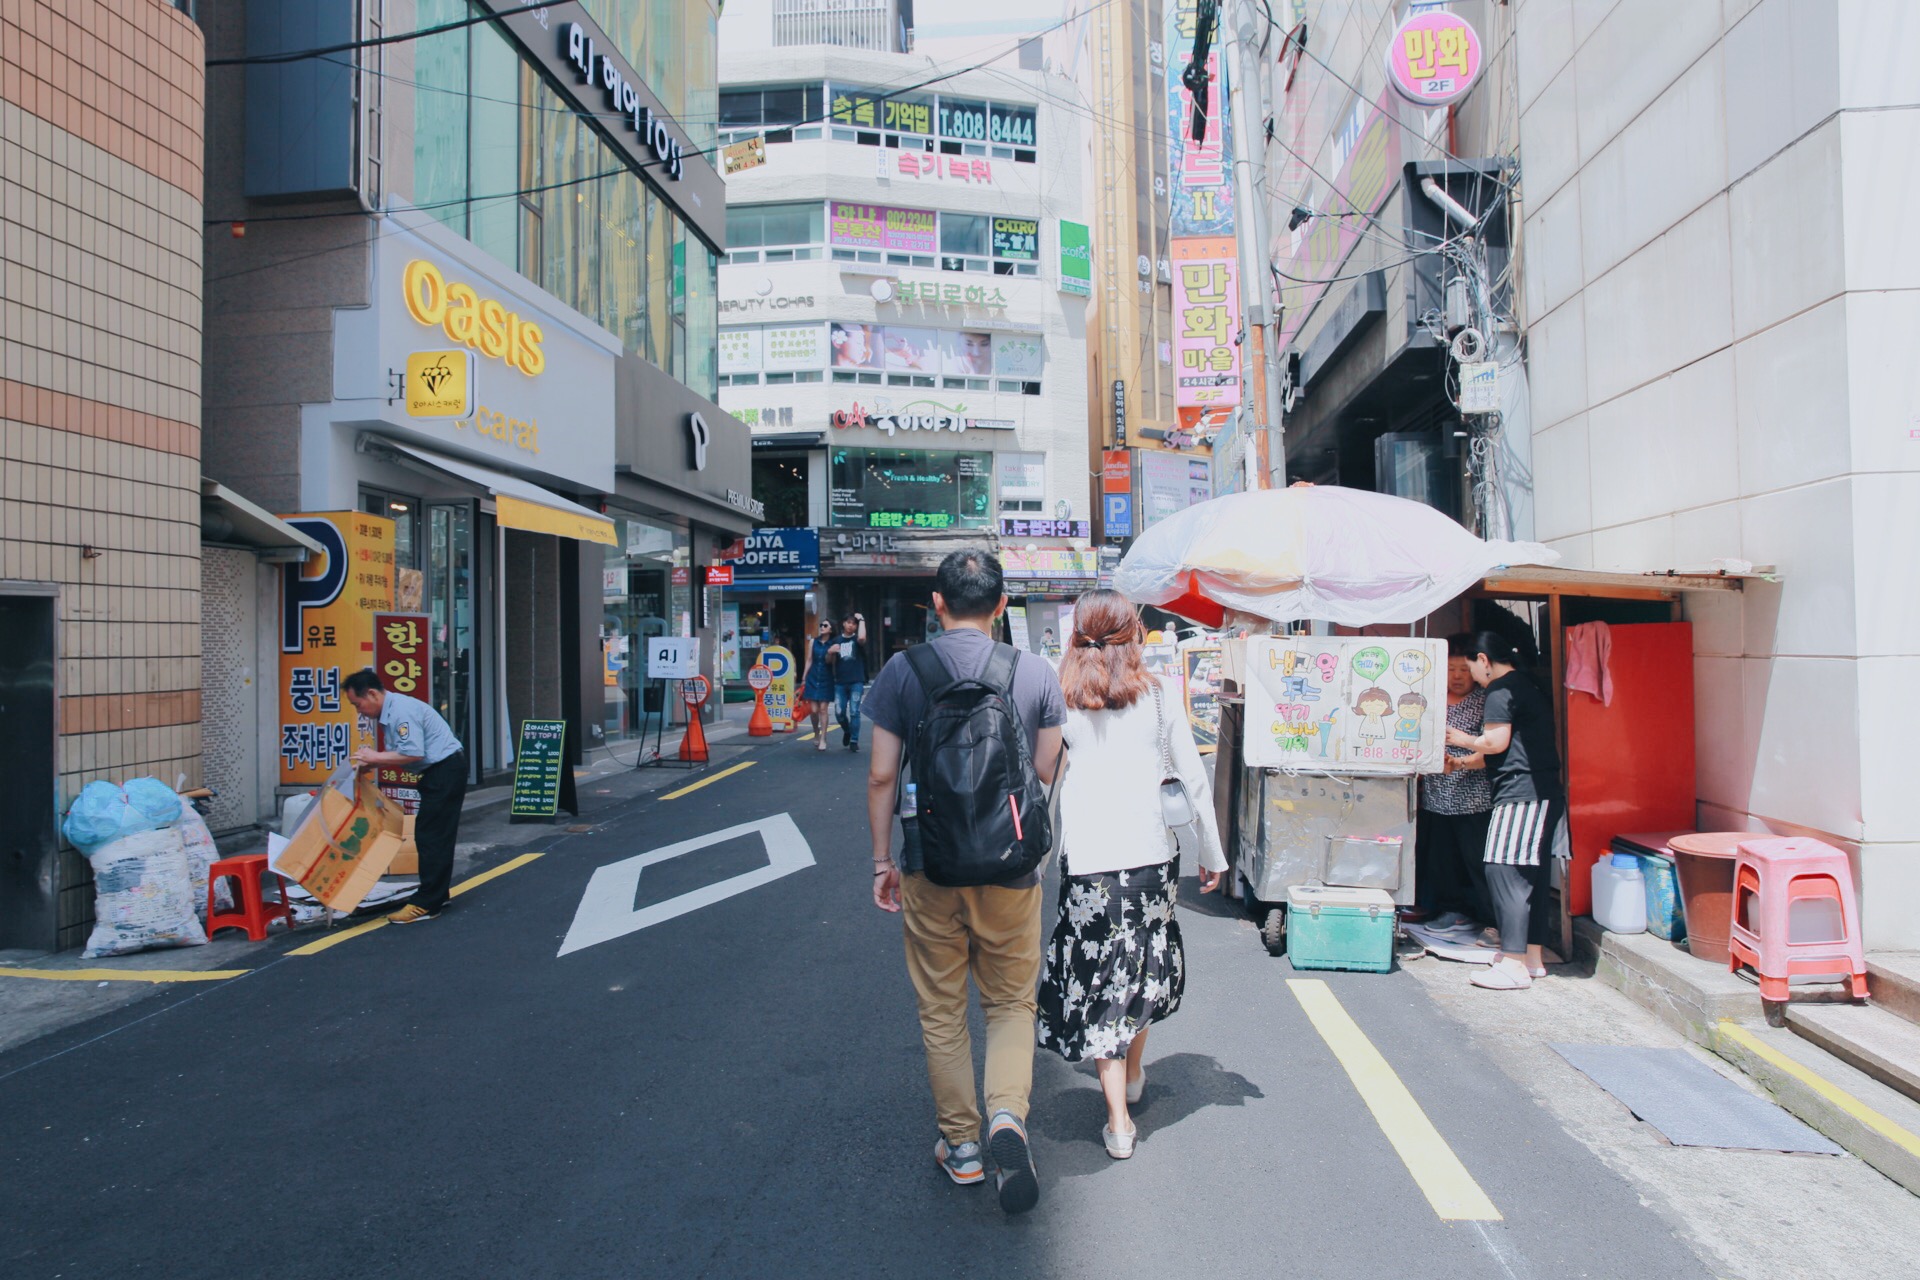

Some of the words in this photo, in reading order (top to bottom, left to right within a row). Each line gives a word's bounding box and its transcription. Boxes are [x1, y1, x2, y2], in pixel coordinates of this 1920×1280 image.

[1403, 26, 1469, 79] 만화
[1428, 80, 1450, 92] 2F
[569, 22, 593, 85] A.J
[602, 54, 639, 131] 헤어
[648, 106, 682, 181] TOSS
[885, 101, 929, 134] 기억법
[940, 108, 984, 140] T.808
[991, 114, 1033, 145] 8444
[748, 138, 758, 150] kt
[898, 153, 943, 180] 속기
[949, 157, 991, 184] 녹취
[837, 205, 876, 223] 하나
[833, 222, 882, 239] 부동산
[718, 298, 764, 313] BEAUTY
[769, 296, 814, 310] LOHAS
[896, 280, 1008, 308] 뷰티로하스
[1180, 264, 1232, 346] 만화
[404, 258, 545, 377] Oasis
[1182, 347, 1234, 372] 마을
[1184, 376, 1235, 387] 24시간업
[1195, 389, 1223, 401] 2F
[474, 405, 540, 454] carat
[917, 475, 941, 483] Healthy
[727, 489, 750, 511] PREMIUM
[750, 498, 765, 517] STORE
[1109, 497, 1127, 522] P
[734, 551, 800, 565] COFFEE
[282, 516, 348, 653] P
[307, 625, 337, 649] 유료
[384, 620, 423, 692] 한양
[659, 649, 677, 663] A.J
[290, 666, 340, 713] 풍년
[764, 693, 786, 706] 풍년
[767, 708, 791, 719] 차타워
[1275, 703, 1310, 720] 딸기
[1271, 720, 1319, 735] 바나나
[282, 721, 350, 771] 주차타워
[1275, 735, 1309, 752] 키위
[382, 769, 398, 782] 3층
